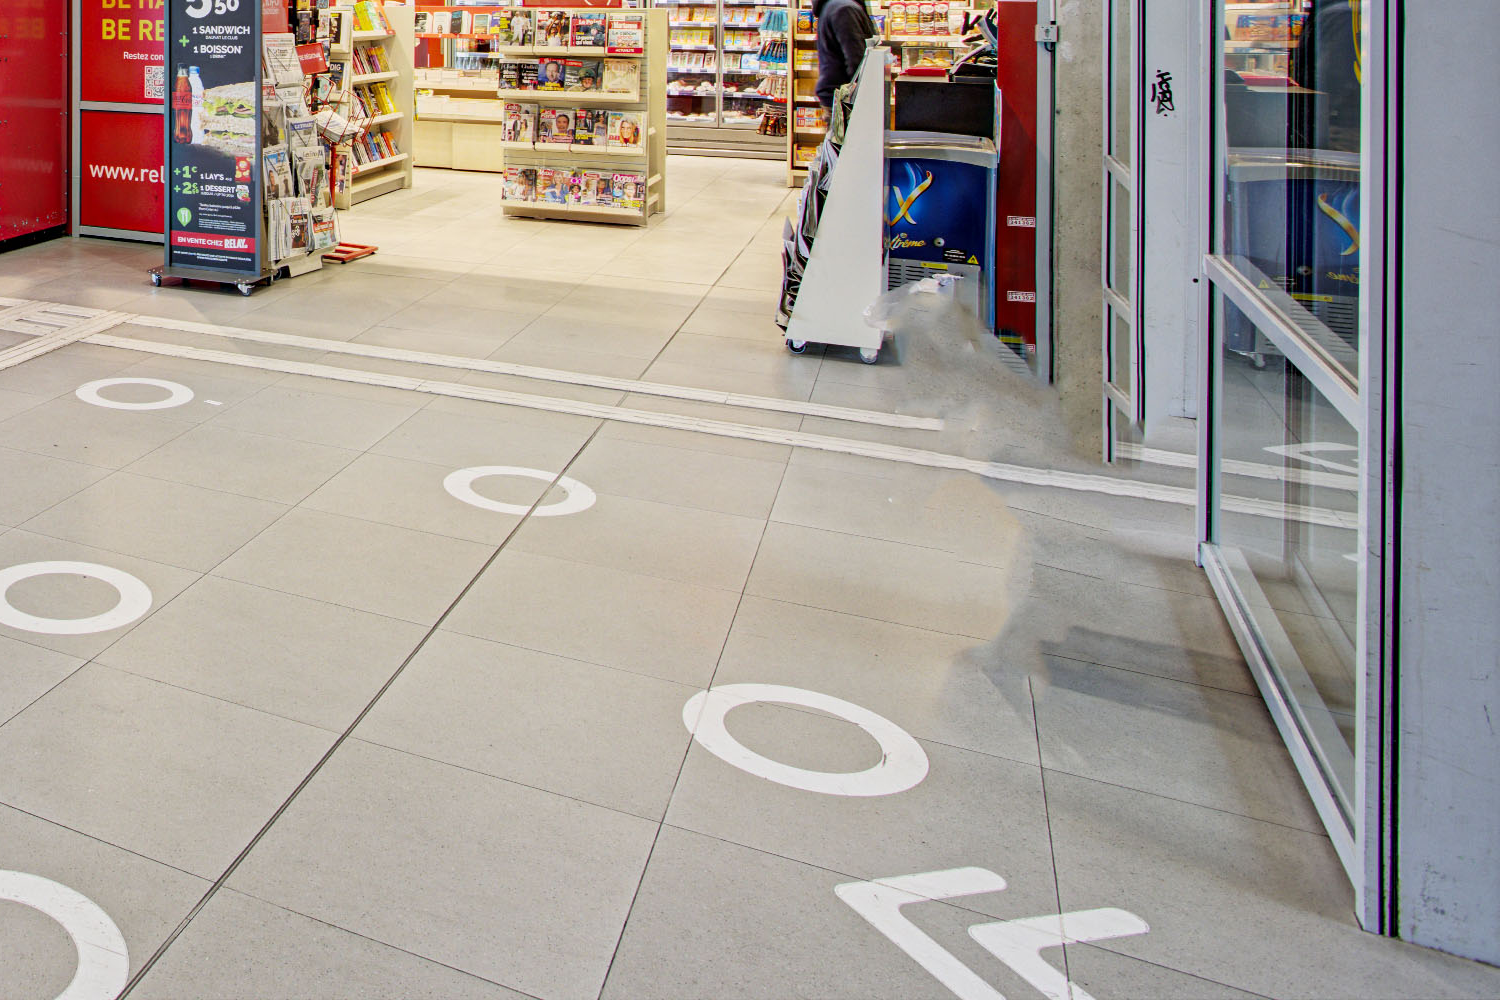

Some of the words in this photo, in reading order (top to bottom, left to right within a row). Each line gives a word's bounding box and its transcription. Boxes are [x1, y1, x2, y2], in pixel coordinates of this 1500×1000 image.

[102, 18, 132, 41] BE
[139, 19, 164, 42] RE
[199, 25, 251, 35] SANDWICH
[200, 44, 242, 54] BOISSON
[123, 51, 149, 61] Restez
[150, 53, 164, 61] con
[89, 164, 165, 184] www.rel
[205, 184, 236, 194] DESSERT
[186, 237, 206, 245] VENTE
[206, 239, 223, 247] CHEZ
